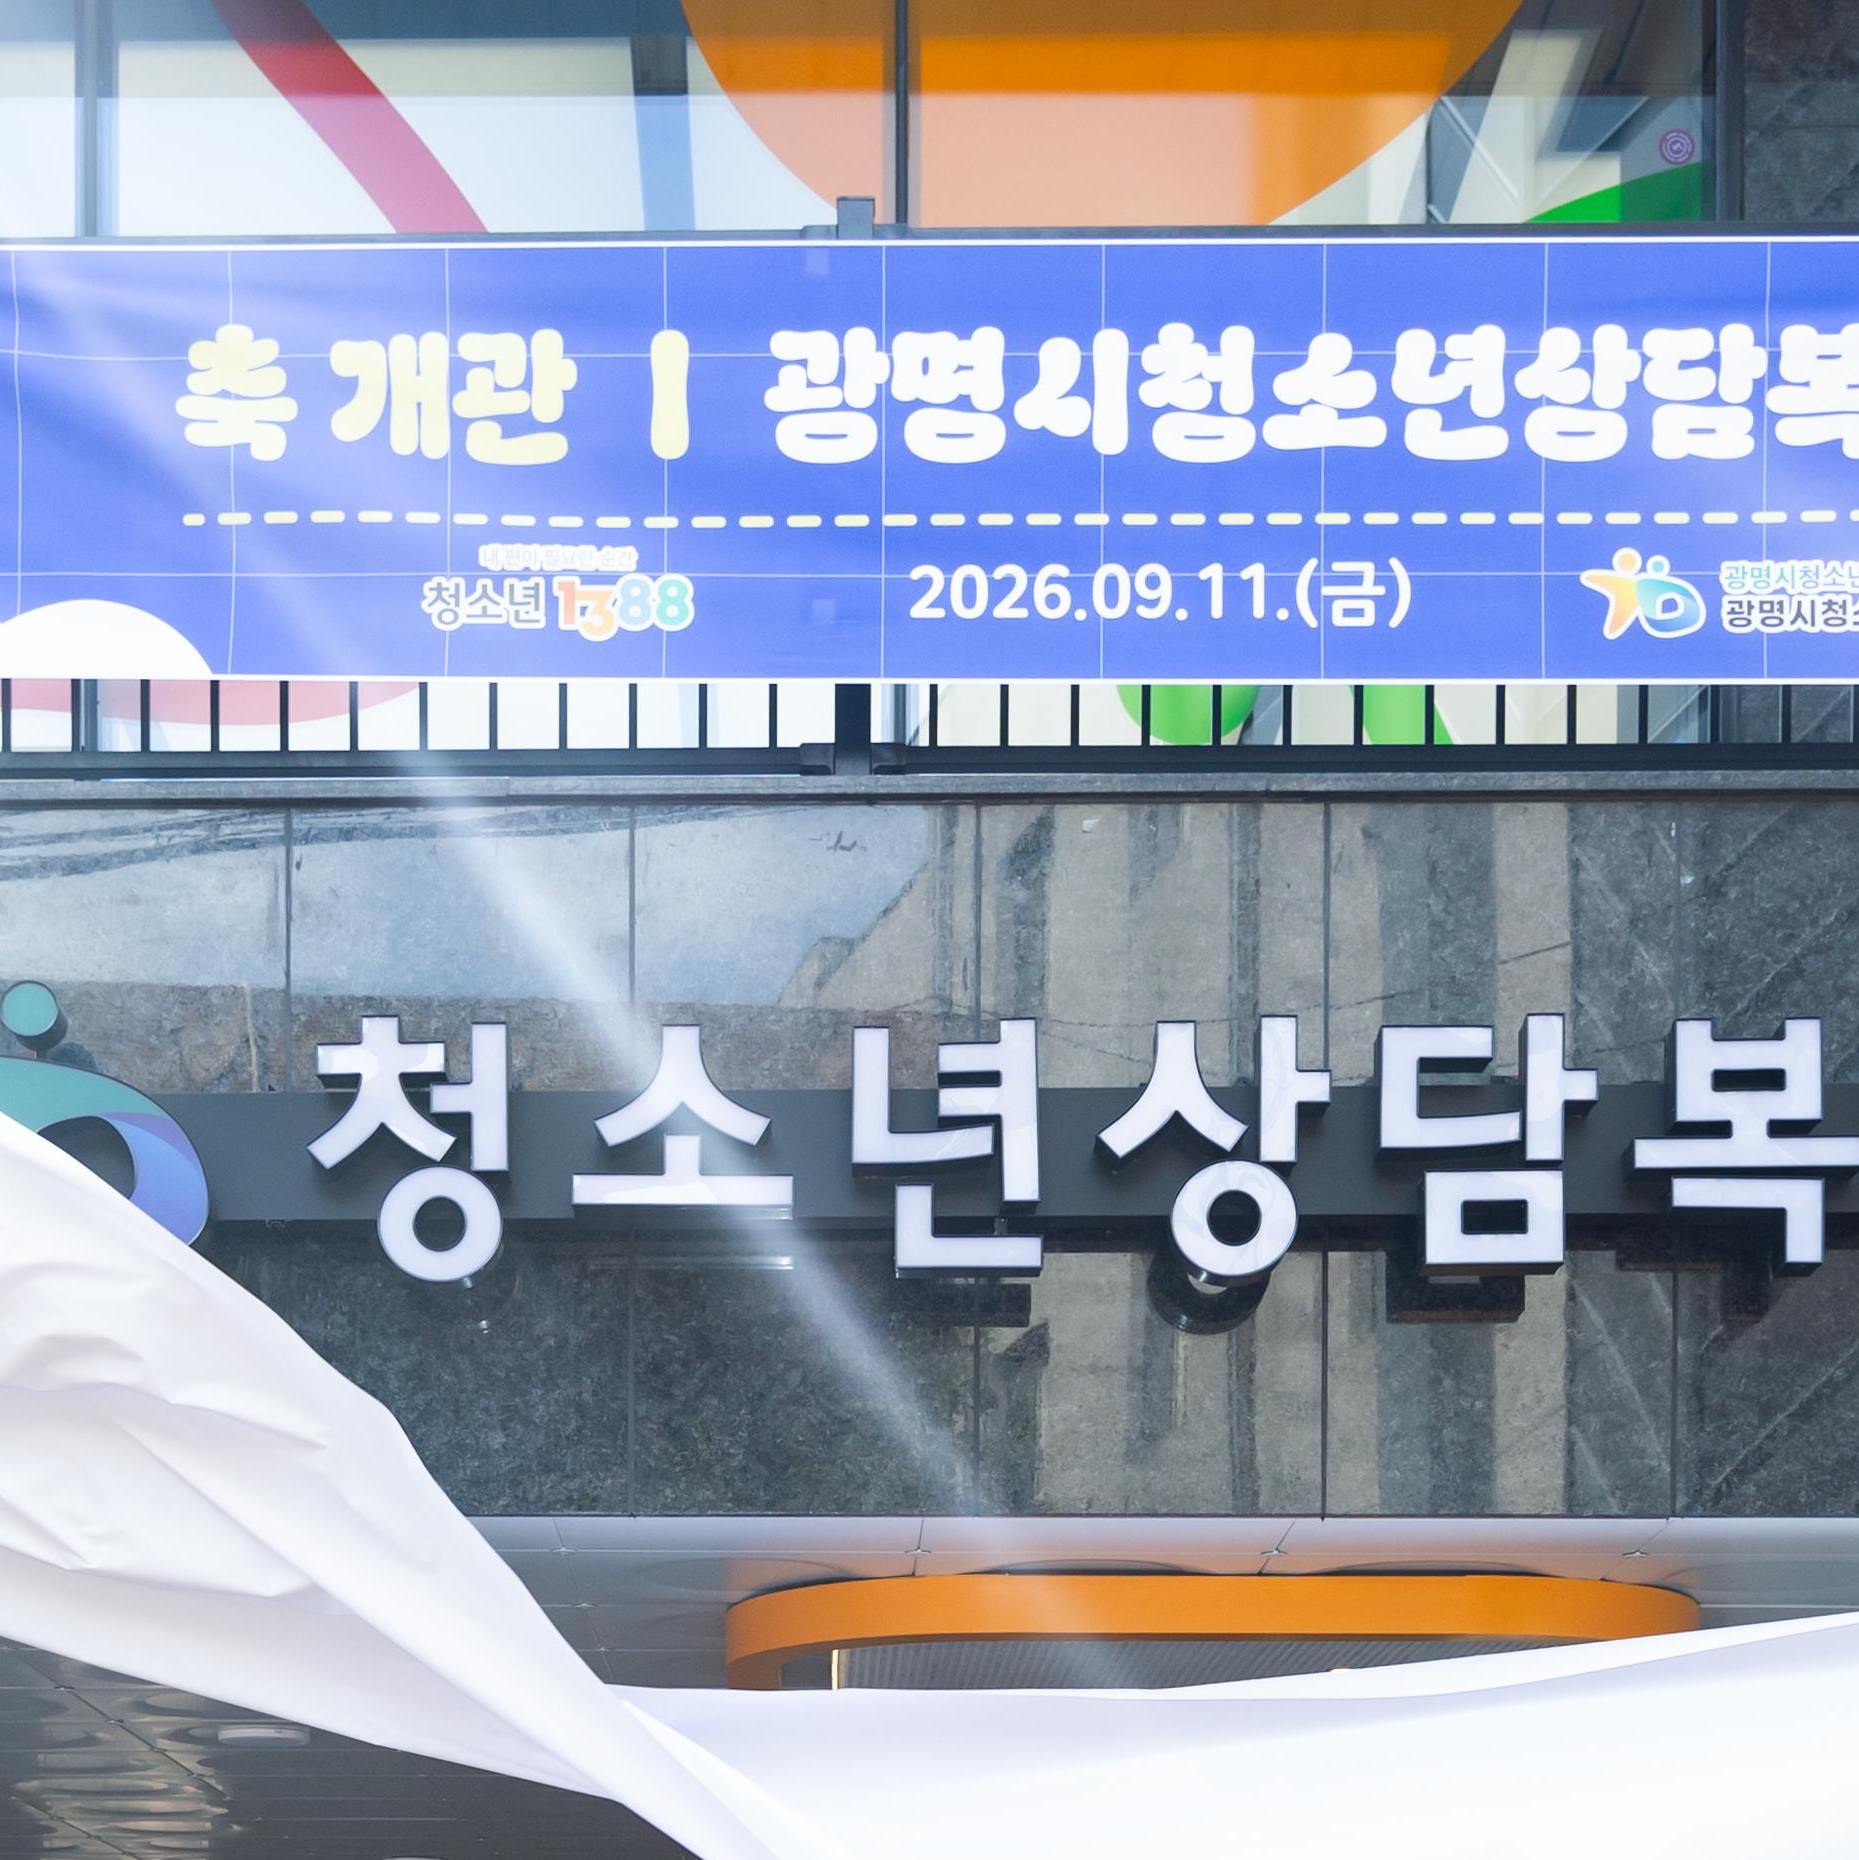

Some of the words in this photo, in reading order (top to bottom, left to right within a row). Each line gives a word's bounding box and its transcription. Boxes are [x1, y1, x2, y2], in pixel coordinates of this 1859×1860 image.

[175, 323, 299, 462] 축
[328, 328, 579, 464] 개관
[426, 581, 542, 626] 청소년
[557, 578, 690, 637] 1388
[907, 556, 1413, 632] 2026.09.11.(금)
